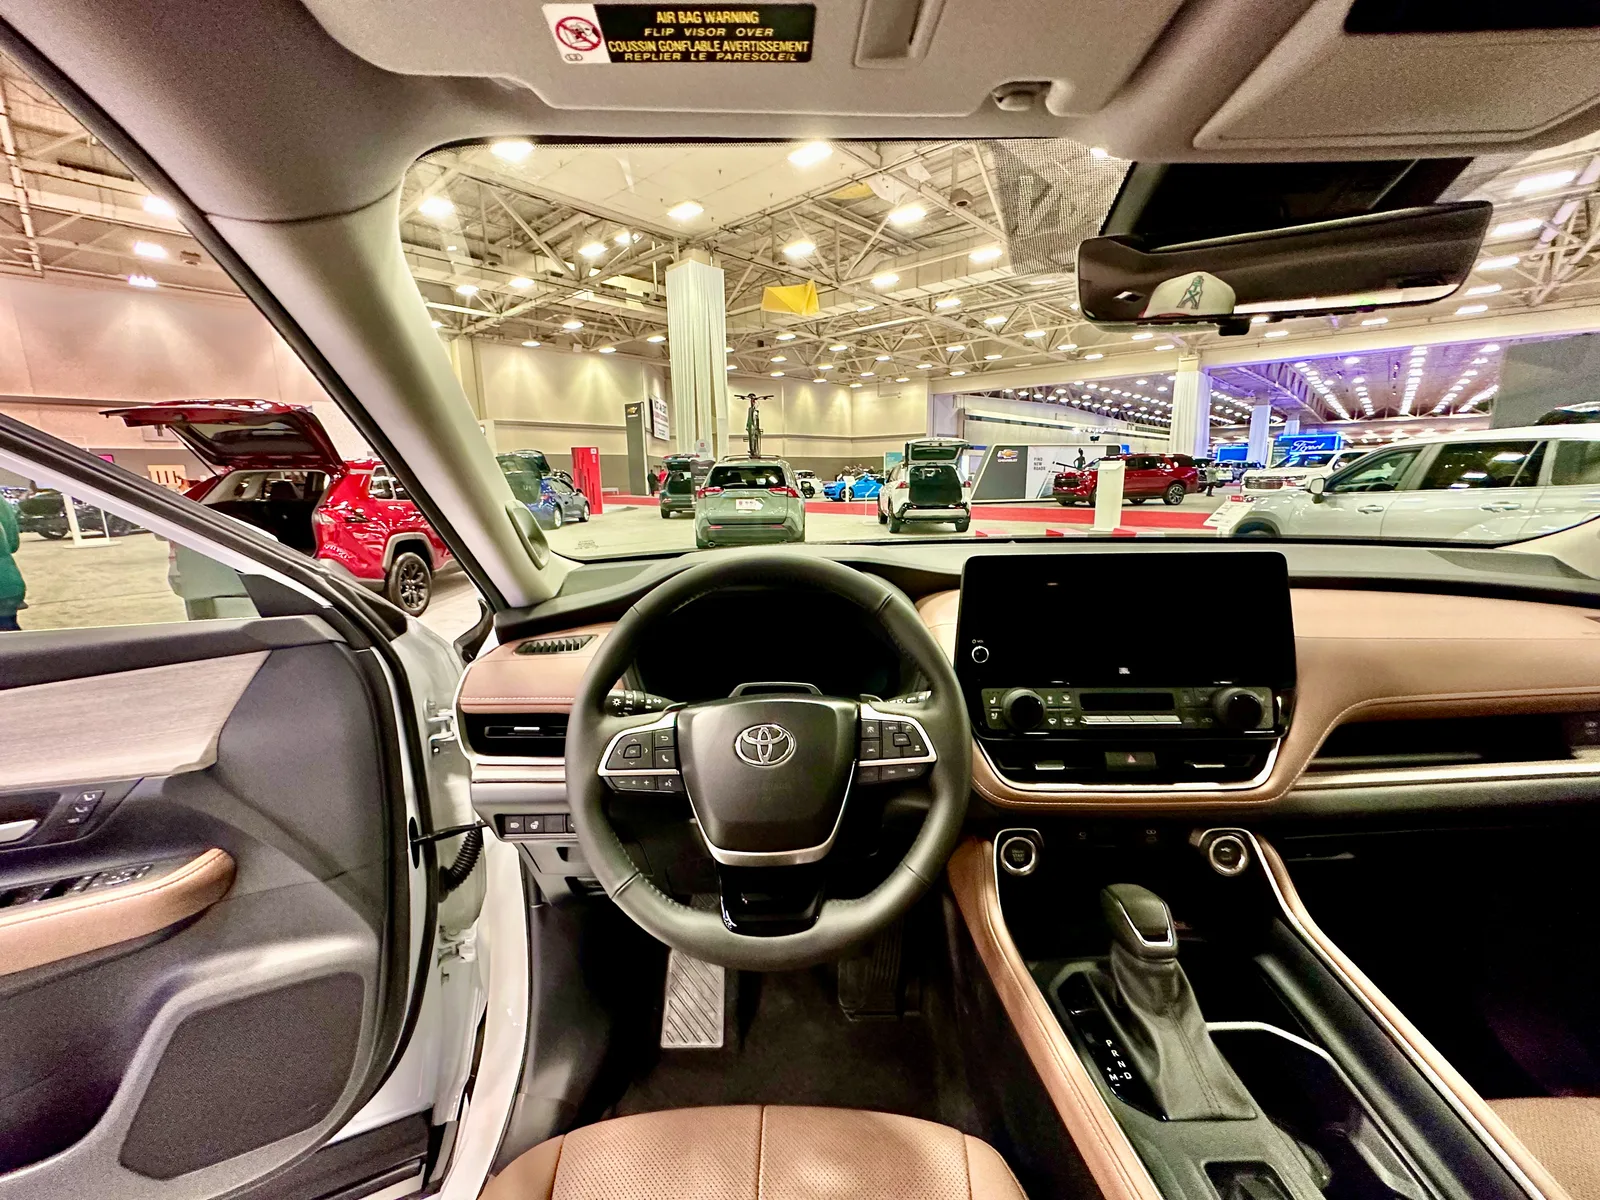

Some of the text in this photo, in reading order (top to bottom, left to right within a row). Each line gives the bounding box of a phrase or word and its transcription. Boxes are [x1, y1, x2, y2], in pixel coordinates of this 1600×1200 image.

[656, 11, 760, 24] AIR BAG WARNING
[644, 27, 774, 37] FLIP VISOR OVER
[608, 40, 810, 52] COUSSIN GONFLABLE AVERTISSEMENT
[624, 52, 797, 61] REPLIER LE PARESOLEIL
[1291, 440, 1325, 452] Ford
[1105, 1039, 1113, 1047] P
[1111, 1049, 1120, 1057] R
[1117, 1060, 1126, 1068] N
[1108, 1071, 1133, 1081] M D
